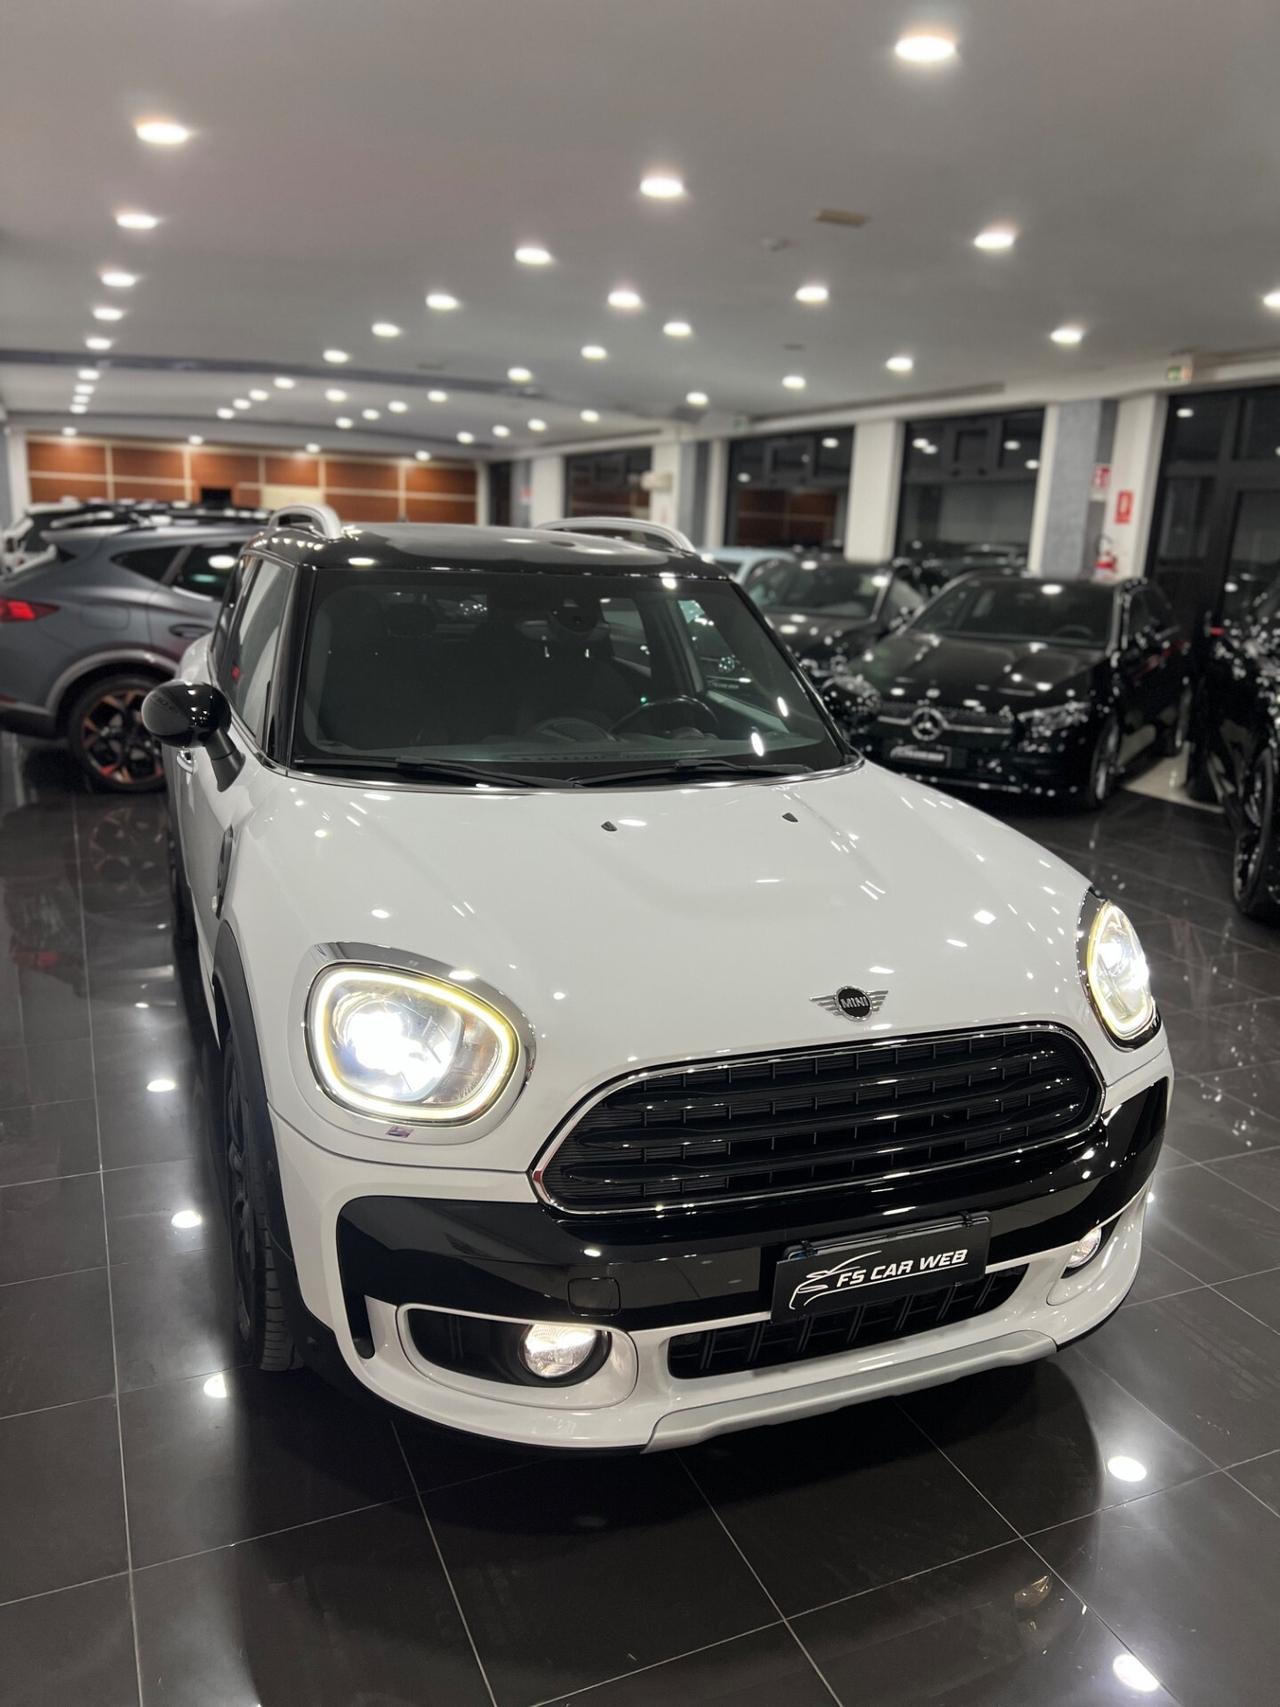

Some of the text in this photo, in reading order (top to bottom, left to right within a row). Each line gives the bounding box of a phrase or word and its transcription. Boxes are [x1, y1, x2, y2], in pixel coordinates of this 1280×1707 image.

[840, 996, 869, 1008] MINI
[836, 1249, 968, 1288] FS CAR WEB
